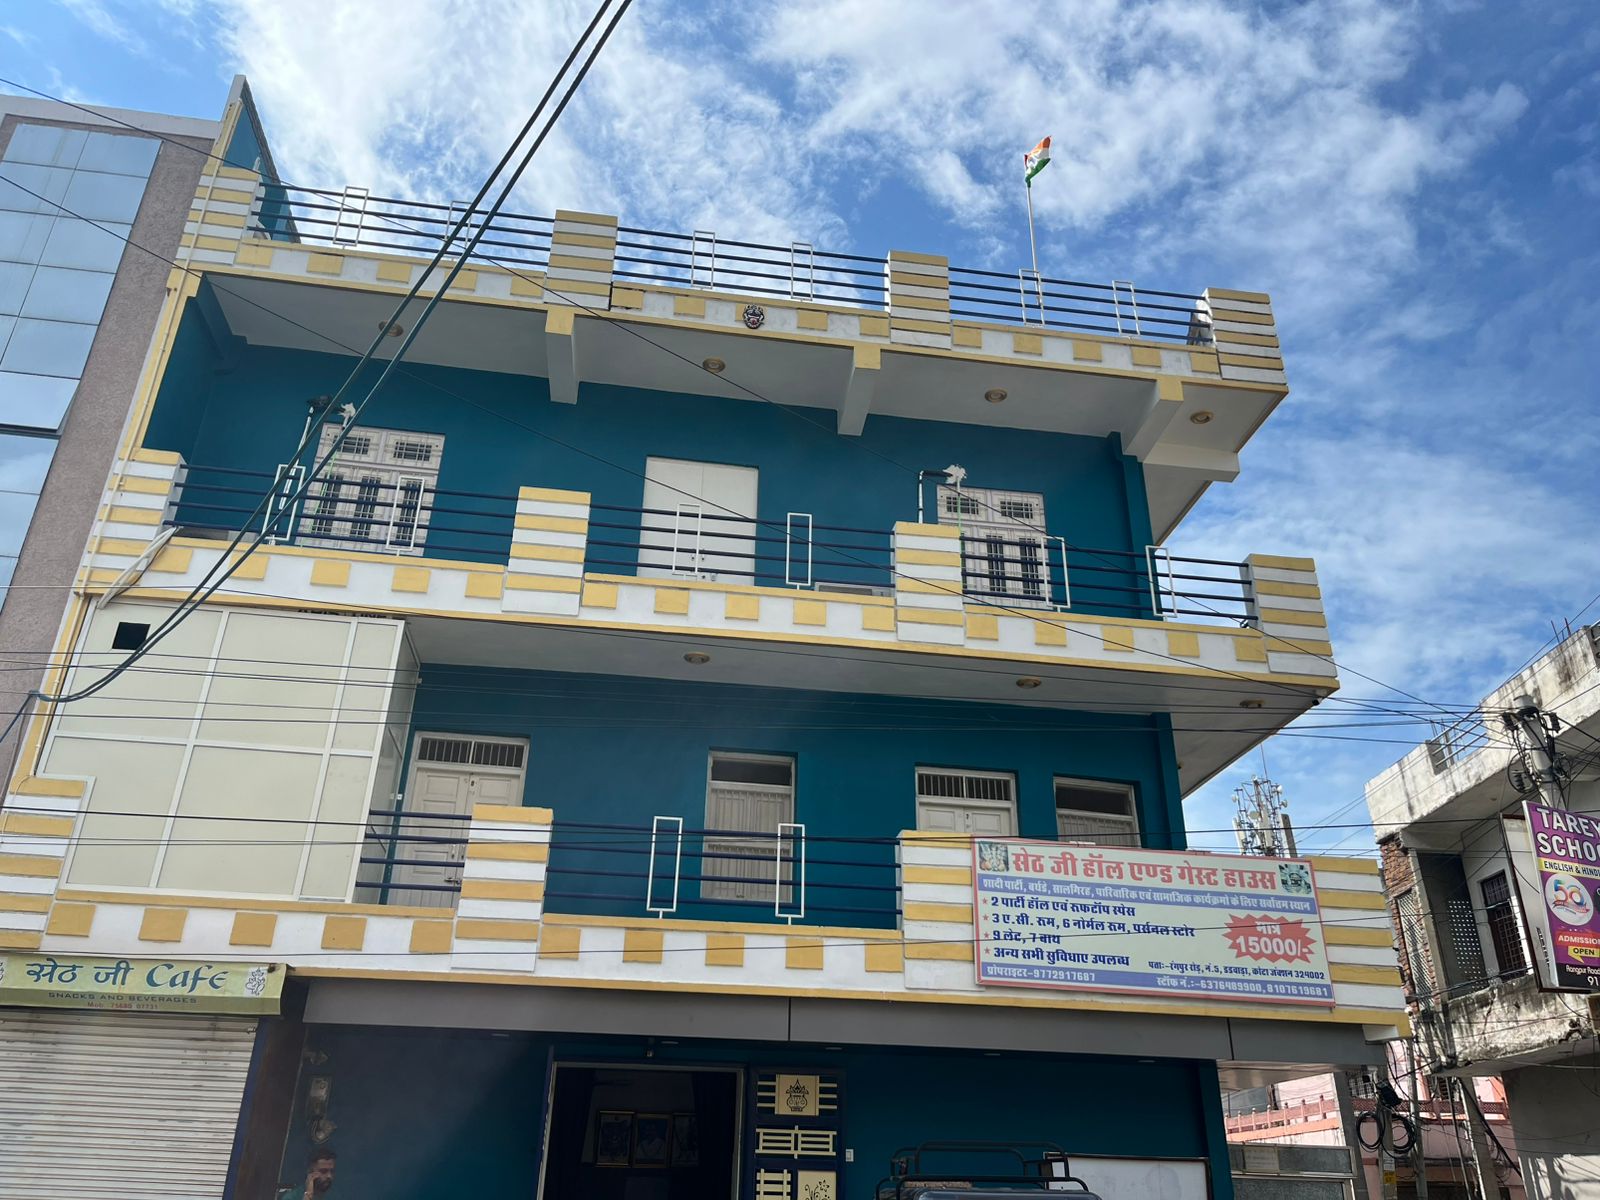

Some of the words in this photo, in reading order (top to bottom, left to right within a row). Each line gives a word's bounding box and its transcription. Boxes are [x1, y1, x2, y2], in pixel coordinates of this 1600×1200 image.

[1537, 832, 1600, 862] SCHO
[1011, 848, 1044, 873] सेठ
[1048, 852, 1077, 876] जी
[1081, 853, 1124, 880] हॉल
[1128, 862, 1173, 883] एण्ड
[1177, 860, 1217, 886] गेस्ट
[1222, 868, 1276, 890] हाउस
[1544, 861, 1574, 873] ENGLISH
[983, 878, 1003, 889] शादी
[1096, 886, 1138, 899] पारिवारिक
[1139, 889, 1152, 901] एवं
[1153, 891, 1192, 903] सामाजिक
[1231, 895, 1240, 906] के
[1241, 896, 1258, 907] लिए
[1289, 900, 1311, 911] स्थान
[991, 897, 999, 906] 2
[1001, 896, 1025, 908] पार्टी
[1028, 897, 1049, 910] हॉल
[1052, 899, 1068, 912] एवं
[1070, 901, 1110, 915] रूफटॉप
[1112, 903, 1135, 916] स्पेस
[992, 914, 999, 923] 3
[1036, 916, 1060, 929] रूम,
[1063, 919, 1070, 928] 6
[1073, 917, 1105, 930] नोर्मल
[1133, 922, 1169, 935] पर्सनल
[1172, 924, 1195, 937] स्टोर
[1255, 920, 1281, 935] मात्र
[993, 930, 1000, 940] 9
[1029, 932, 1037, 943] 7
[1236, 935, 1309, 957] 15000/-
[1558, 935, 1600, 945] ADMISSIO
[994, 947, 1019, 959] अन्य
[1021, 947, 1044, 960] सभी
[1091, 953, 1130, 966] उपलब्ध
[1573, 947, 1595, 956] OPEN
[26, 957, 84, 984] सेठ
[94, 959, 135, 986] जी
[1252, 966, 1268, 976] कोटा
[1294, 970, 1325, 980] 324002
[48, 992, 95, 1000] SNACKS
[128, 995, 197, 1004] BEVERAGES
